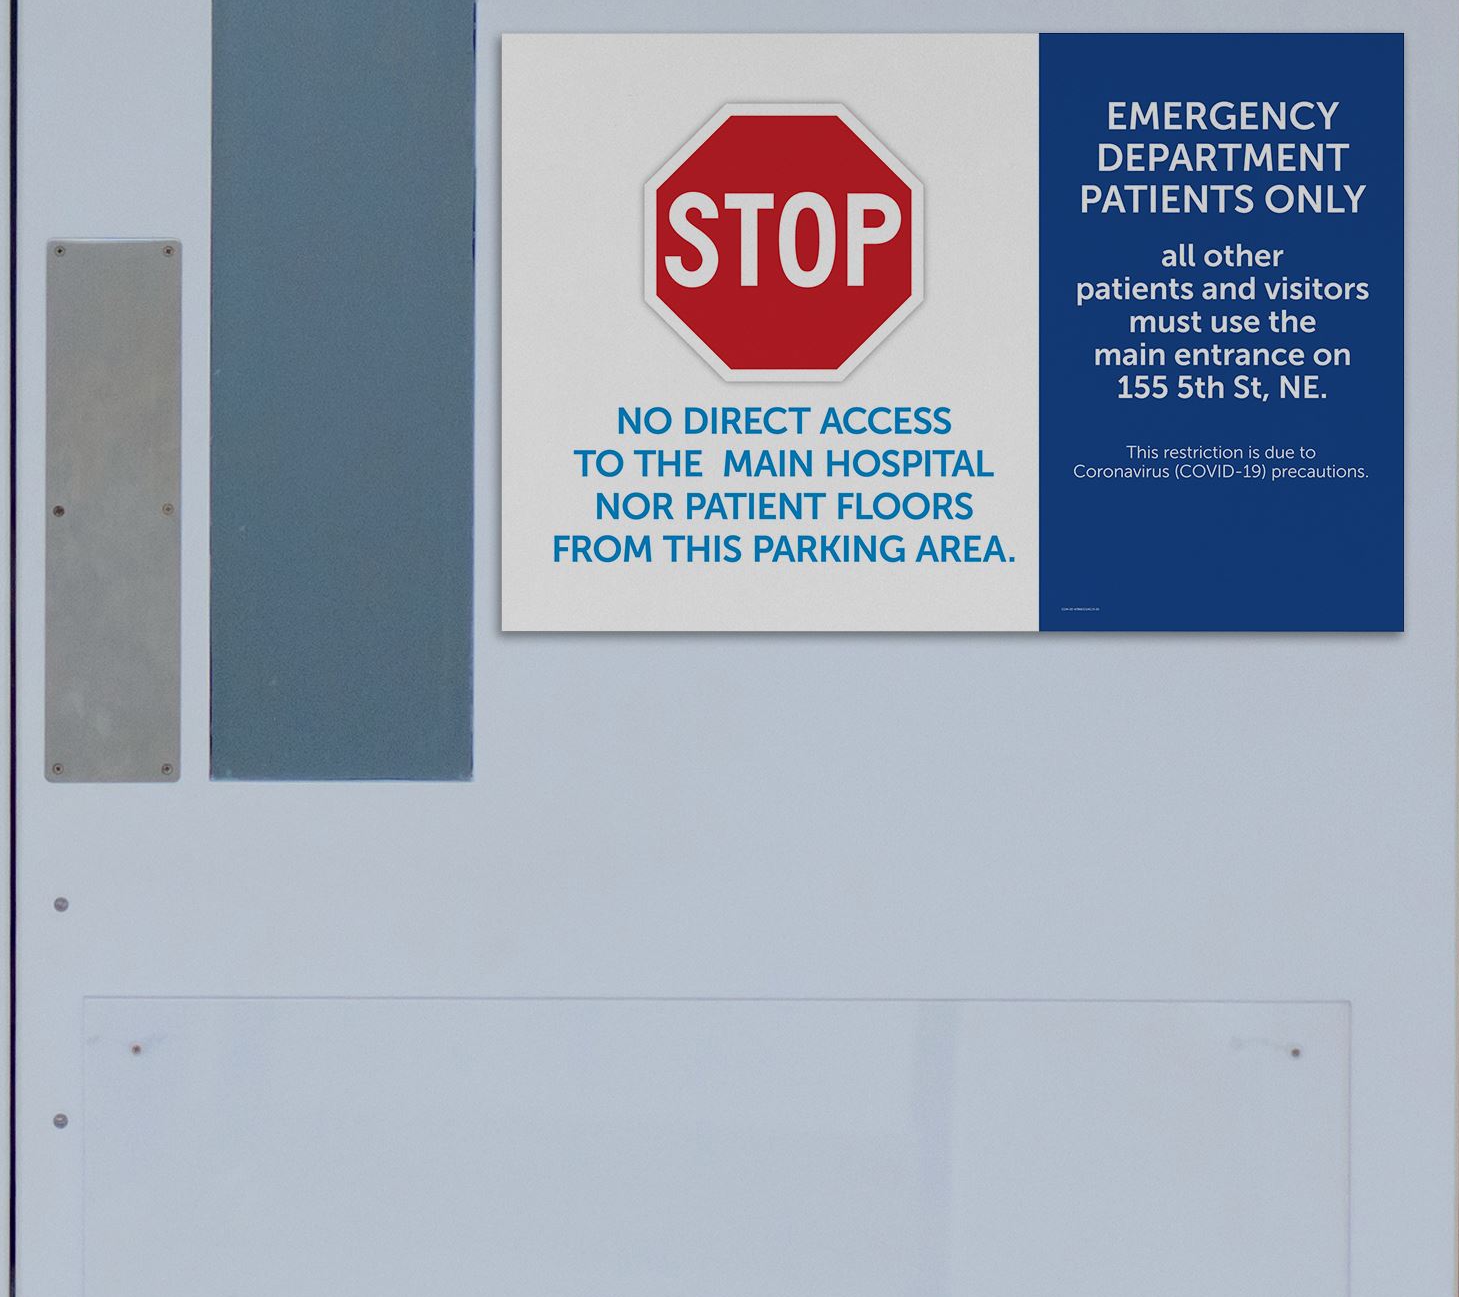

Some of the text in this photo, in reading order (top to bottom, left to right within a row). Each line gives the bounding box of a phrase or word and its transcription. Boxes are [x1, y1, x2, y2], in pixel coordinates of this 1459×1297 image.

[1108, 100, 1340, 131] EMERGENCY
[1098, 142, 1350, 172] DEPARTMENT
[1081, 184, 1367, 214] PATIENTS ONLY
[664, 191, 902, 288] STOP
[1161, 243, 1285, 268] all other
[1076, 276, 1370, 307] patients and visitors
[1129, 309, 1317, 334] must use the
[1094, 341, 1351, 367] main entrance on
[1117, 374, 1327, 402] 155 5th St, NE.
[617, 405, 953, 436] NO DIRECT ACCESS
[572, 448, 996, 479] TO THE MAIN HOSPITAL
[1125, 445, 1317, 460] This restriction is due to
[1073, 463, 1369, 482] Coronavirus (COVID-19) precautions.
[595, 490, 974, 522] NOR PATIENT FLOORS
[552, 533, 1016, 564] FROM THIS PARKING AREA.
